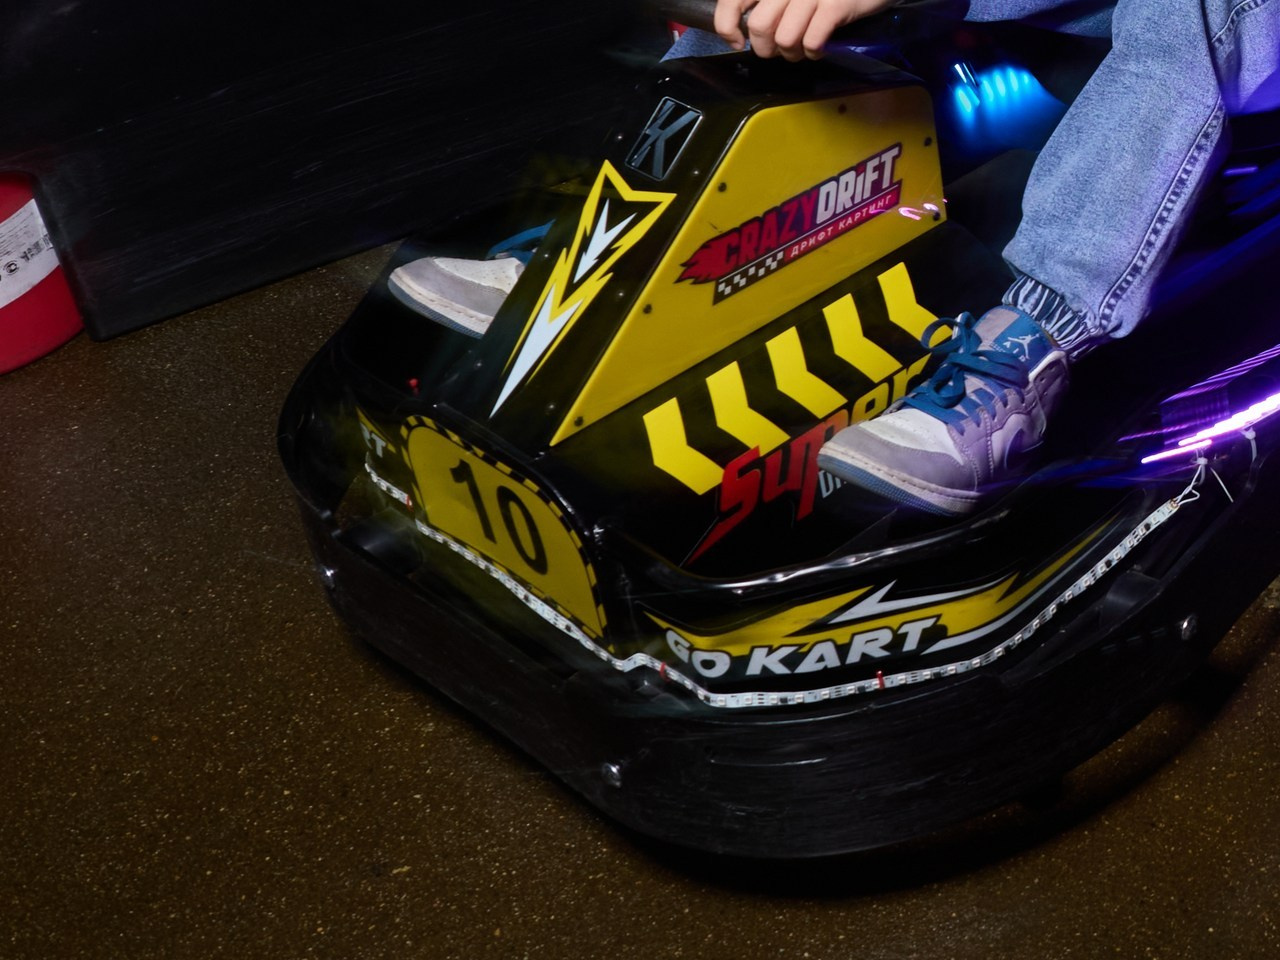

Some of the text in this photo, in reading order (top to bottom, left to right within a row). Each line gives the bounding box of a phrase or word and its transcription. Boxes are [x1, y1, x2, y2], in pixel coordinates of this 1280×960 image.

[790, 195, 893, 258] ДРИФТ КАРТИНГ
[449, 458, 549, 576] 10
[664, 617, 940, 679] GO KART
